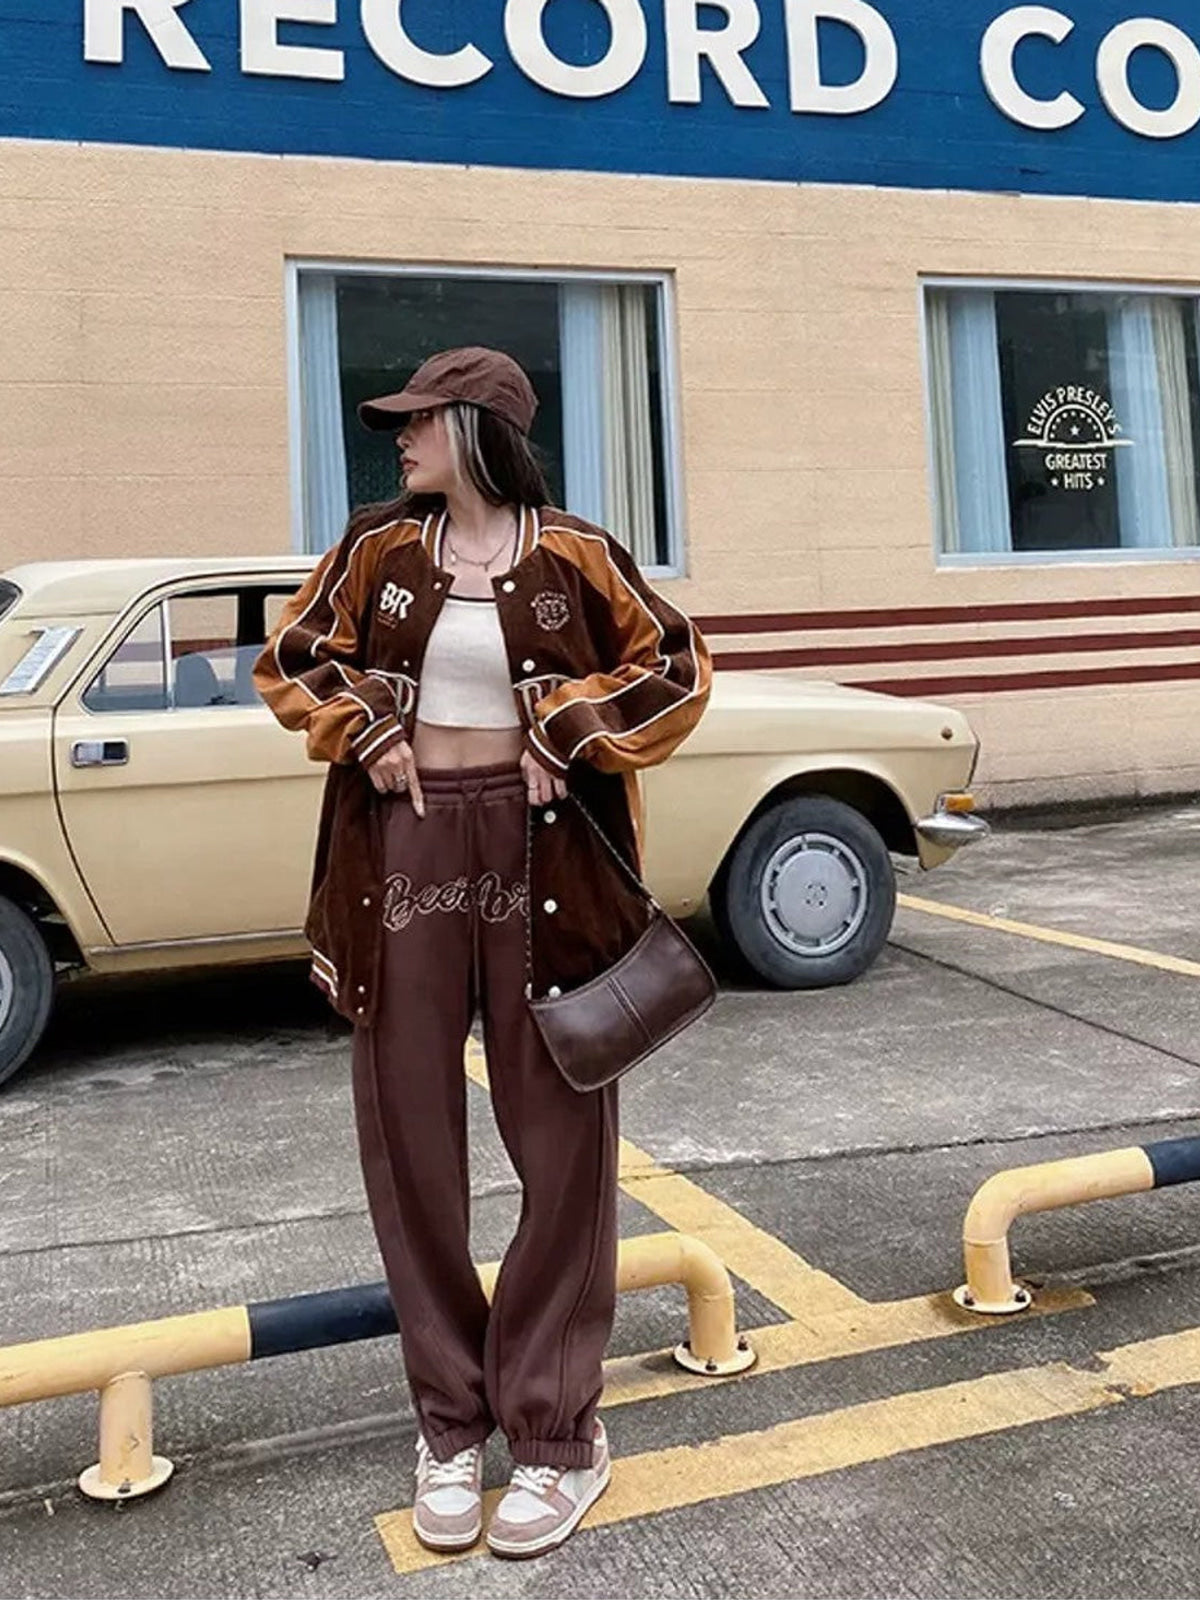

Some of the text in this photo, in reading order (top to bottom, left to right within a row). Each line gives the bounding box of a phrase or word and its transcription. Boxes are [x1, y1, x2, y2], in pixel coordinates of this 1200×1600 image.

[979, 5, 1200, 138] CO
[1026, 392, 1058, 435] ELVIS
[1044, 453, 1107, 470] GREATEST
[1063, 472, 1094, 489] HITS
